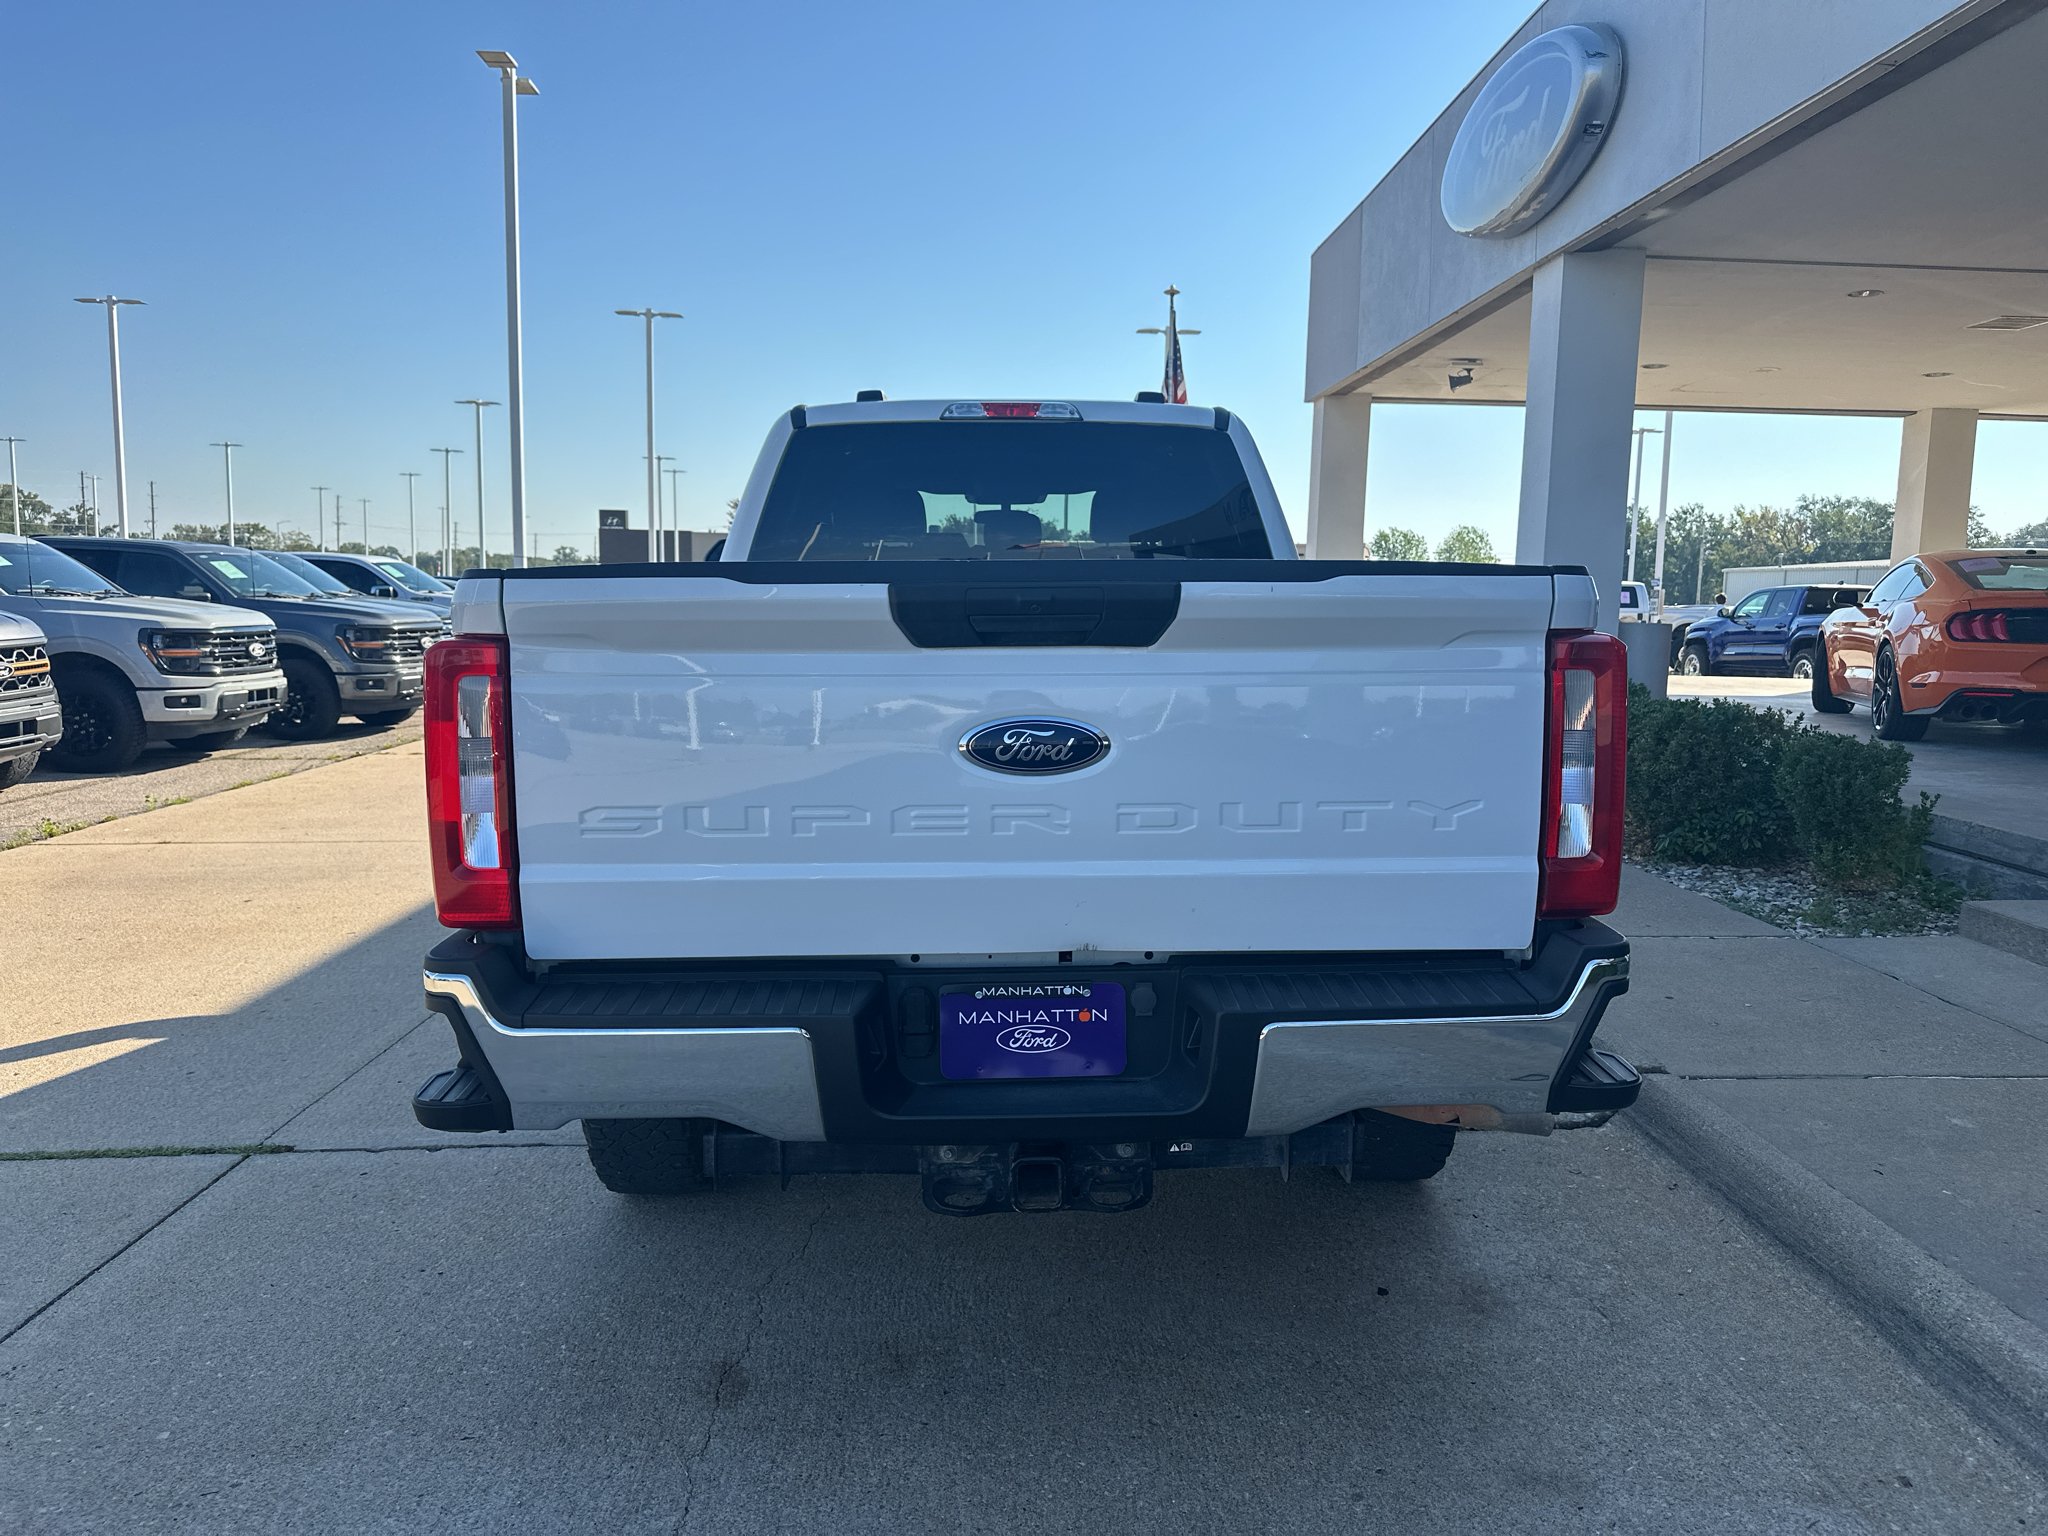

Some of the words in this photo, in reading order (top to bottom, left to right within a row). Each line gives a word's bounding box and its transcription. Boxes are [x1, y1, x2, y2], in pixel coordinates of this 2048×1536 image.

[1474, 84, 1552, 193] Ford
[995, 728, 1075, 762] Ford
[578, 803, 1071, 839] SUPER
[1116, 799, 1484, 834] DUTY
[981, 985, 1084, 998] MANHATTN
[958, 1008, 1108, 1025] MANHATTN
[1009, 1028, 1058, 1048] Ford
